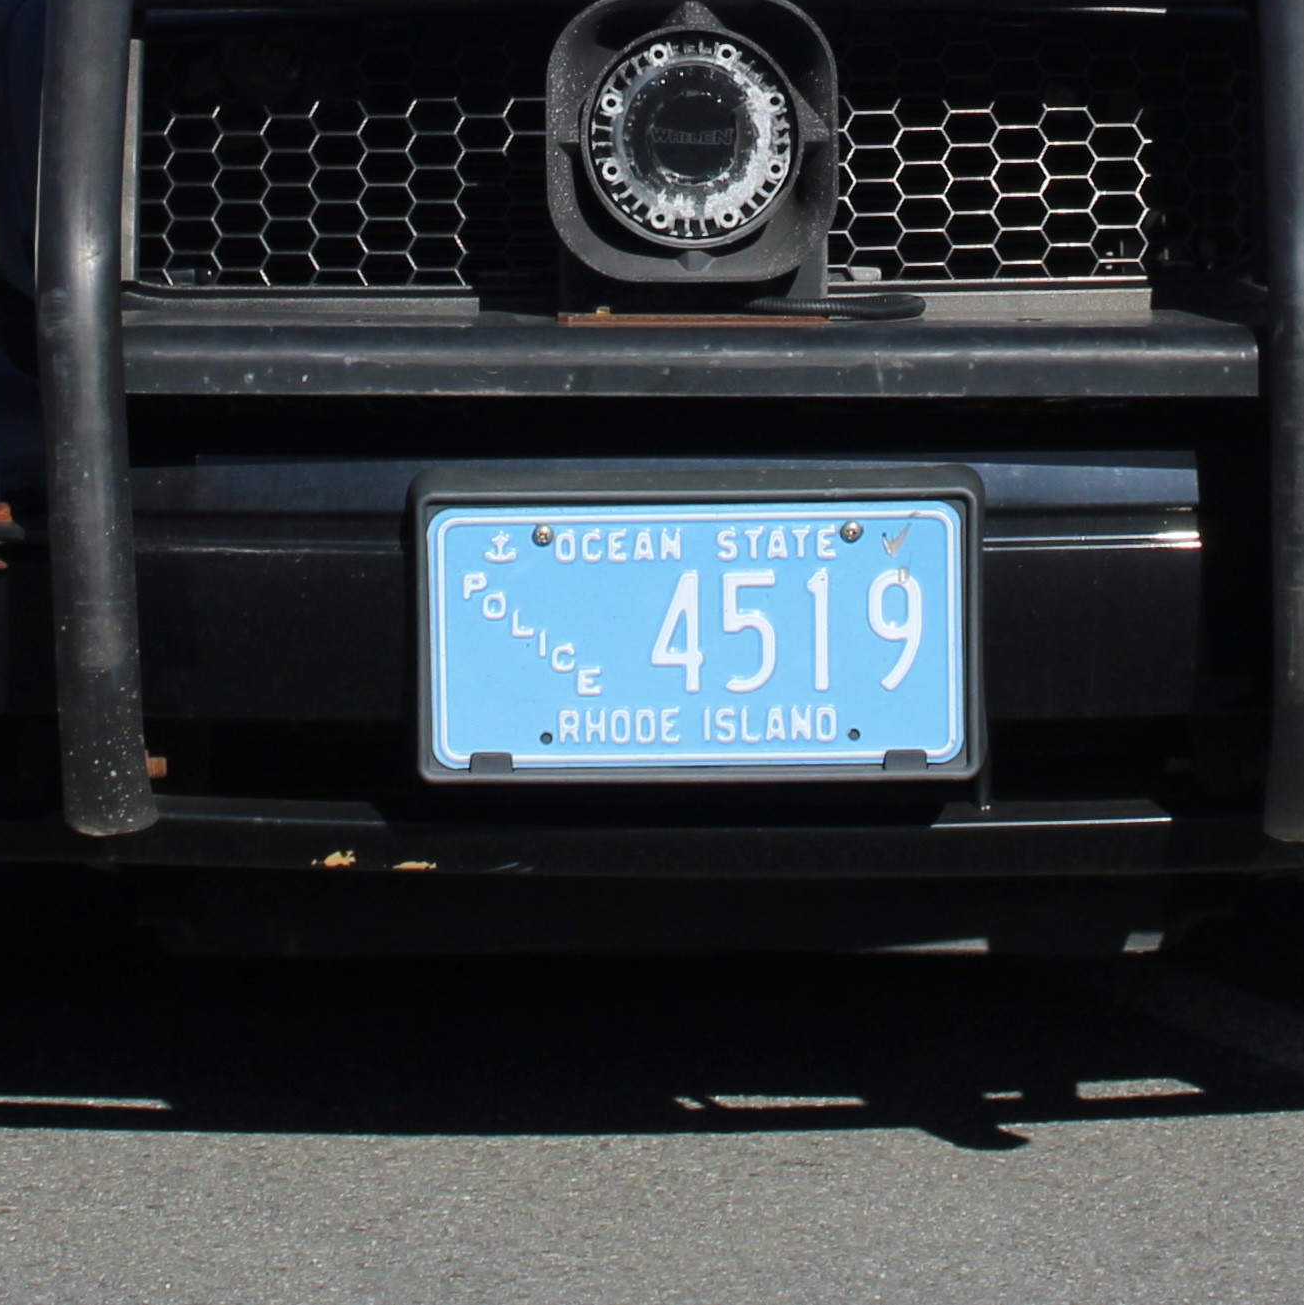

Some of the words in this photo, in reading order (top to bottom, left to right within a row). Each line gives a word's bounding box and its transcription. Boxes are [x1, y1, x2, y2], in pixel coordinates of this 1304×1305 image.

[648, 127, 734, 146] WHELEN
[555, 527, 683, 563] OCEAN
[717, 525, 838, 562] STATE
[462, 572, 602, 697] POLICE
[651, 567, 923, 694] 4519
[558, 706, 681, 744] RHODE
[703, 705, 838, 743] ISLAND
